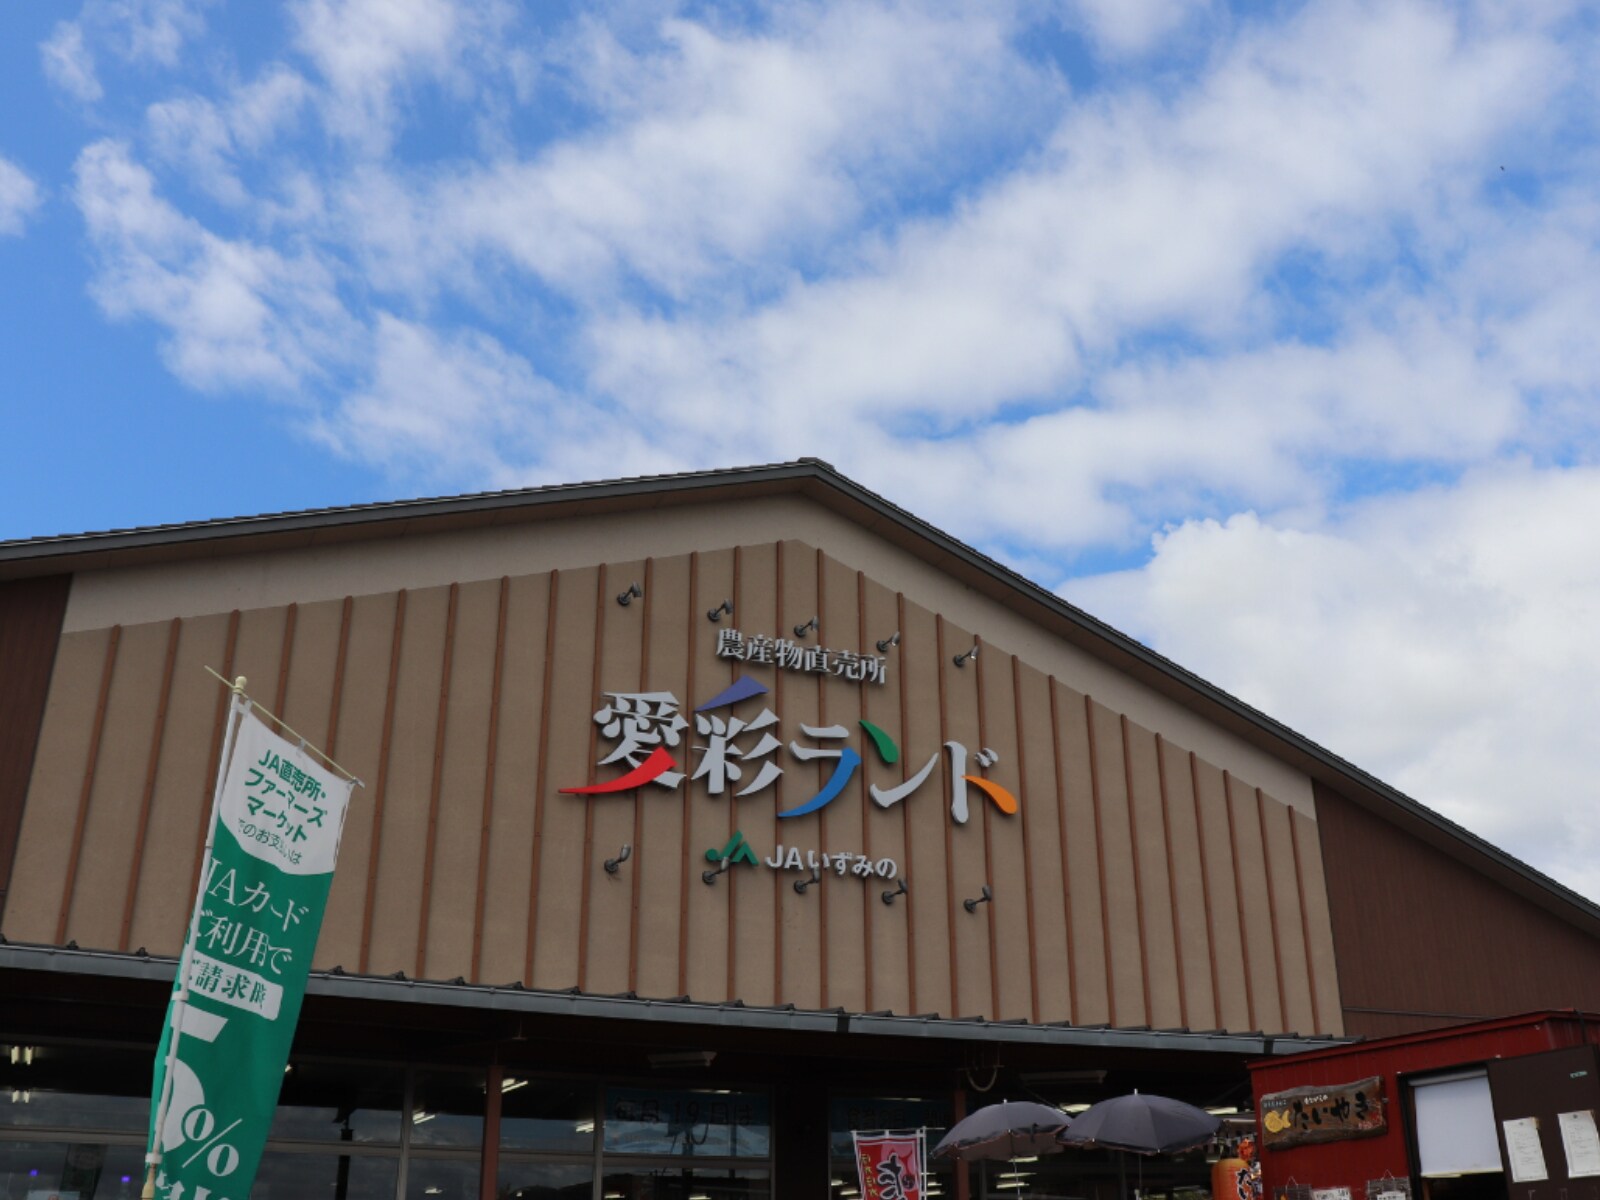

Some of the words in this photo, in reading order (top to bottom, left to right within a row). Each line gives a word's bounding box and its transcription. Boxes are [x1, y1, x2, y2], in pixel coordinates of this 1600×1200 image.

[715, 628, 888, 685] 農産物直売所
[558, 675, 1018, 825] 愛彩ランド
[244, 767, 328, 828] ファーマーズ
[247, 794, 308, 843] マーケット
[765, 844, 898, 880] JAいずみの
